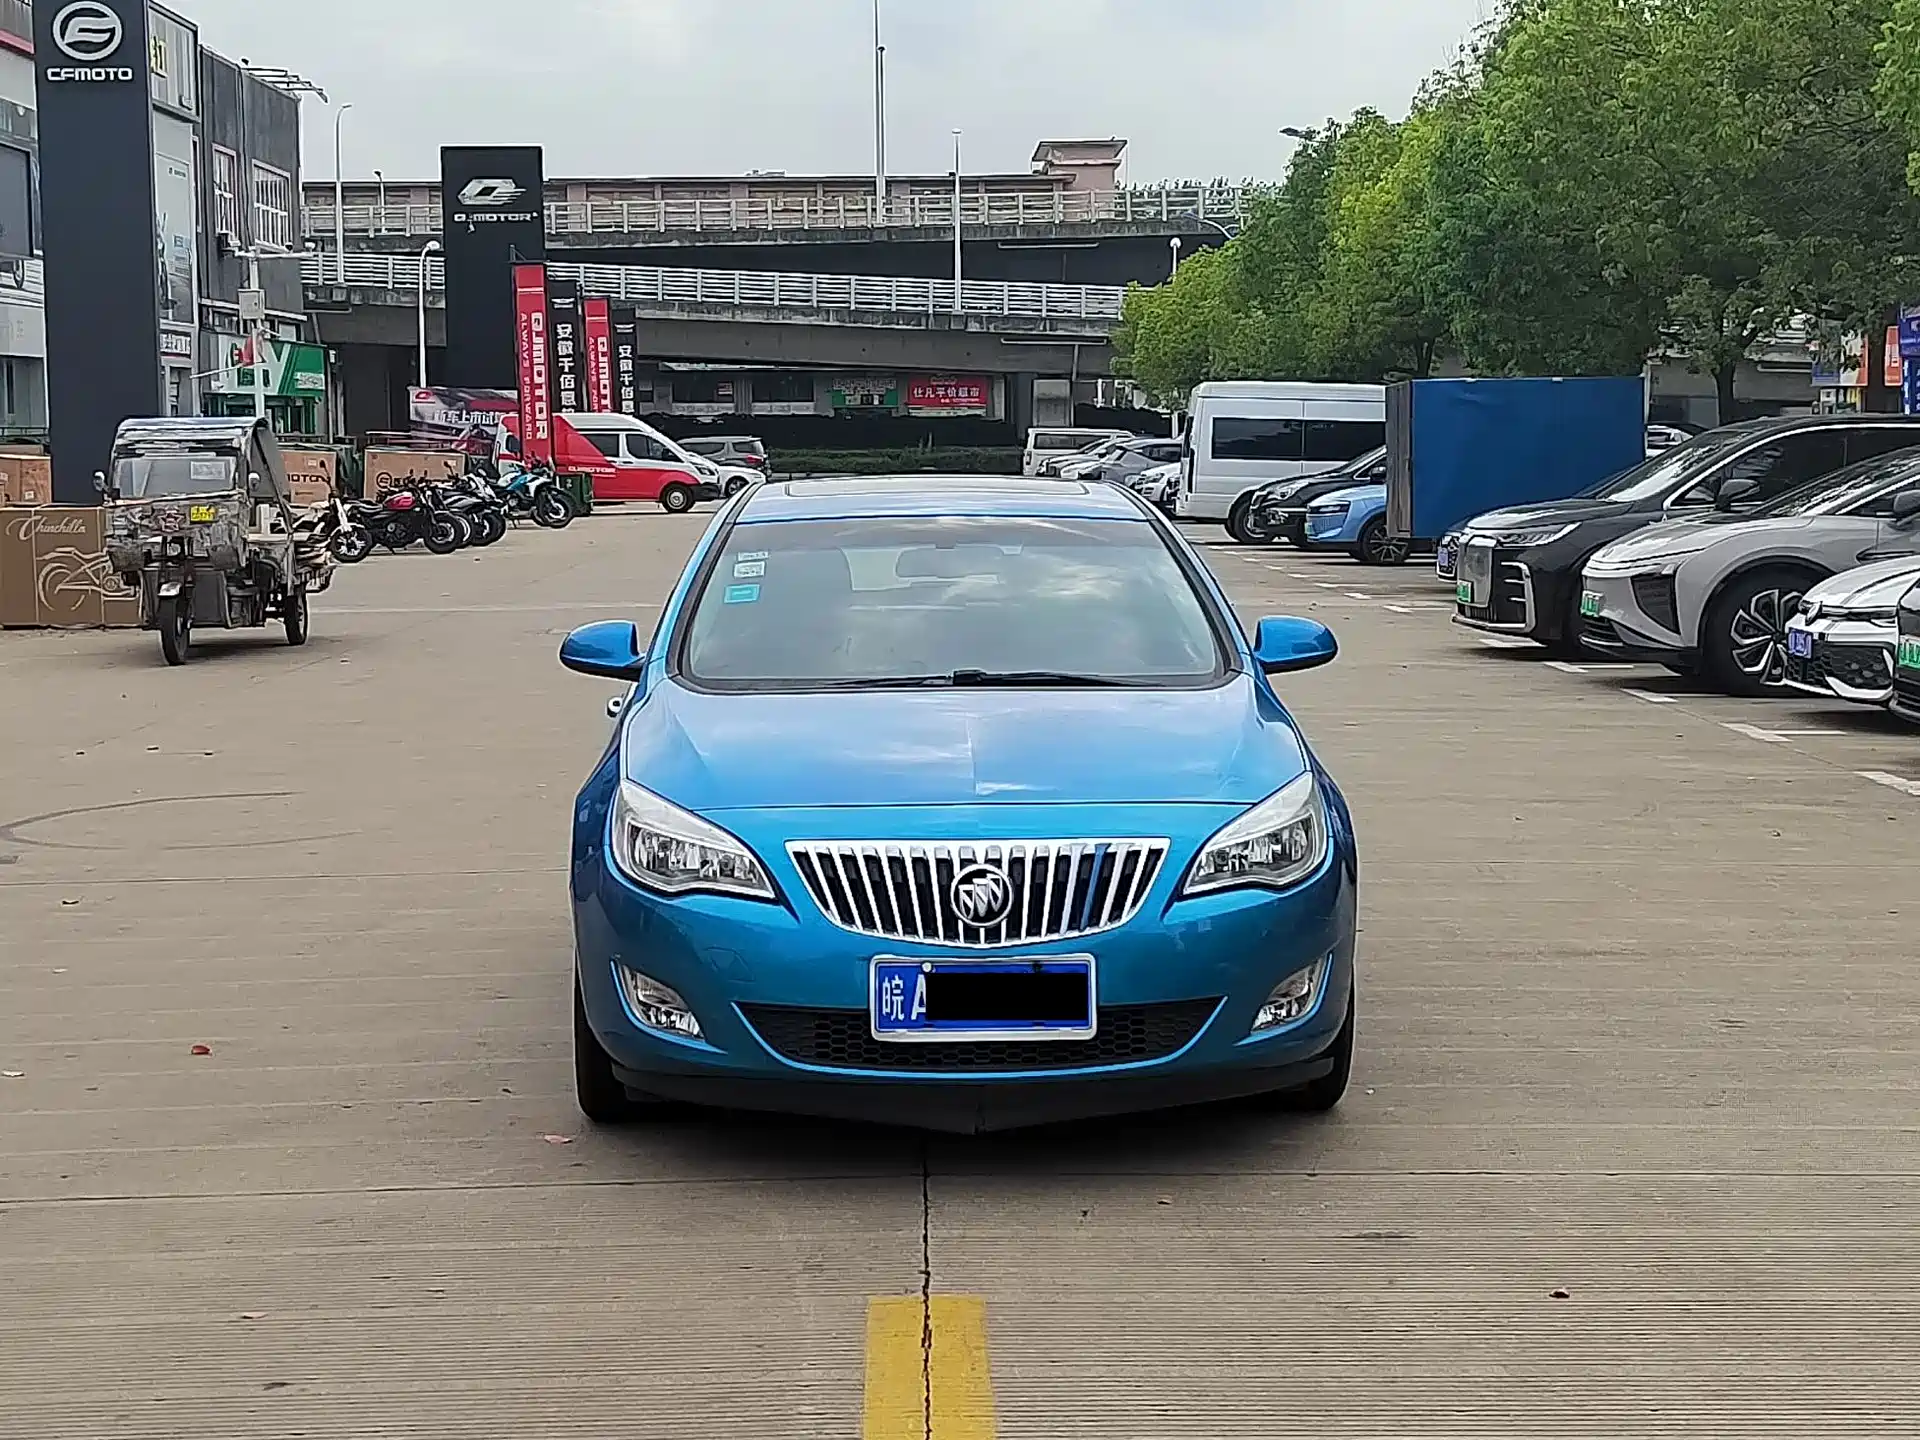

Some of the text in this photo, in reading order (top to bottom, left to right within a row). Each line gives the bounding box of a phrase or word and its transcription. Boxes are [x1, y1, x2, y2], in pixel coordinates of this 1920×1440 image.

[47, 68, 133, 80] CFMOTO
[520, 313, 533, 440] ALWAYS FORWARD
[531, 312, 548, 439] QJMOTOR
[598, 336, 611, 412] QJMOT
